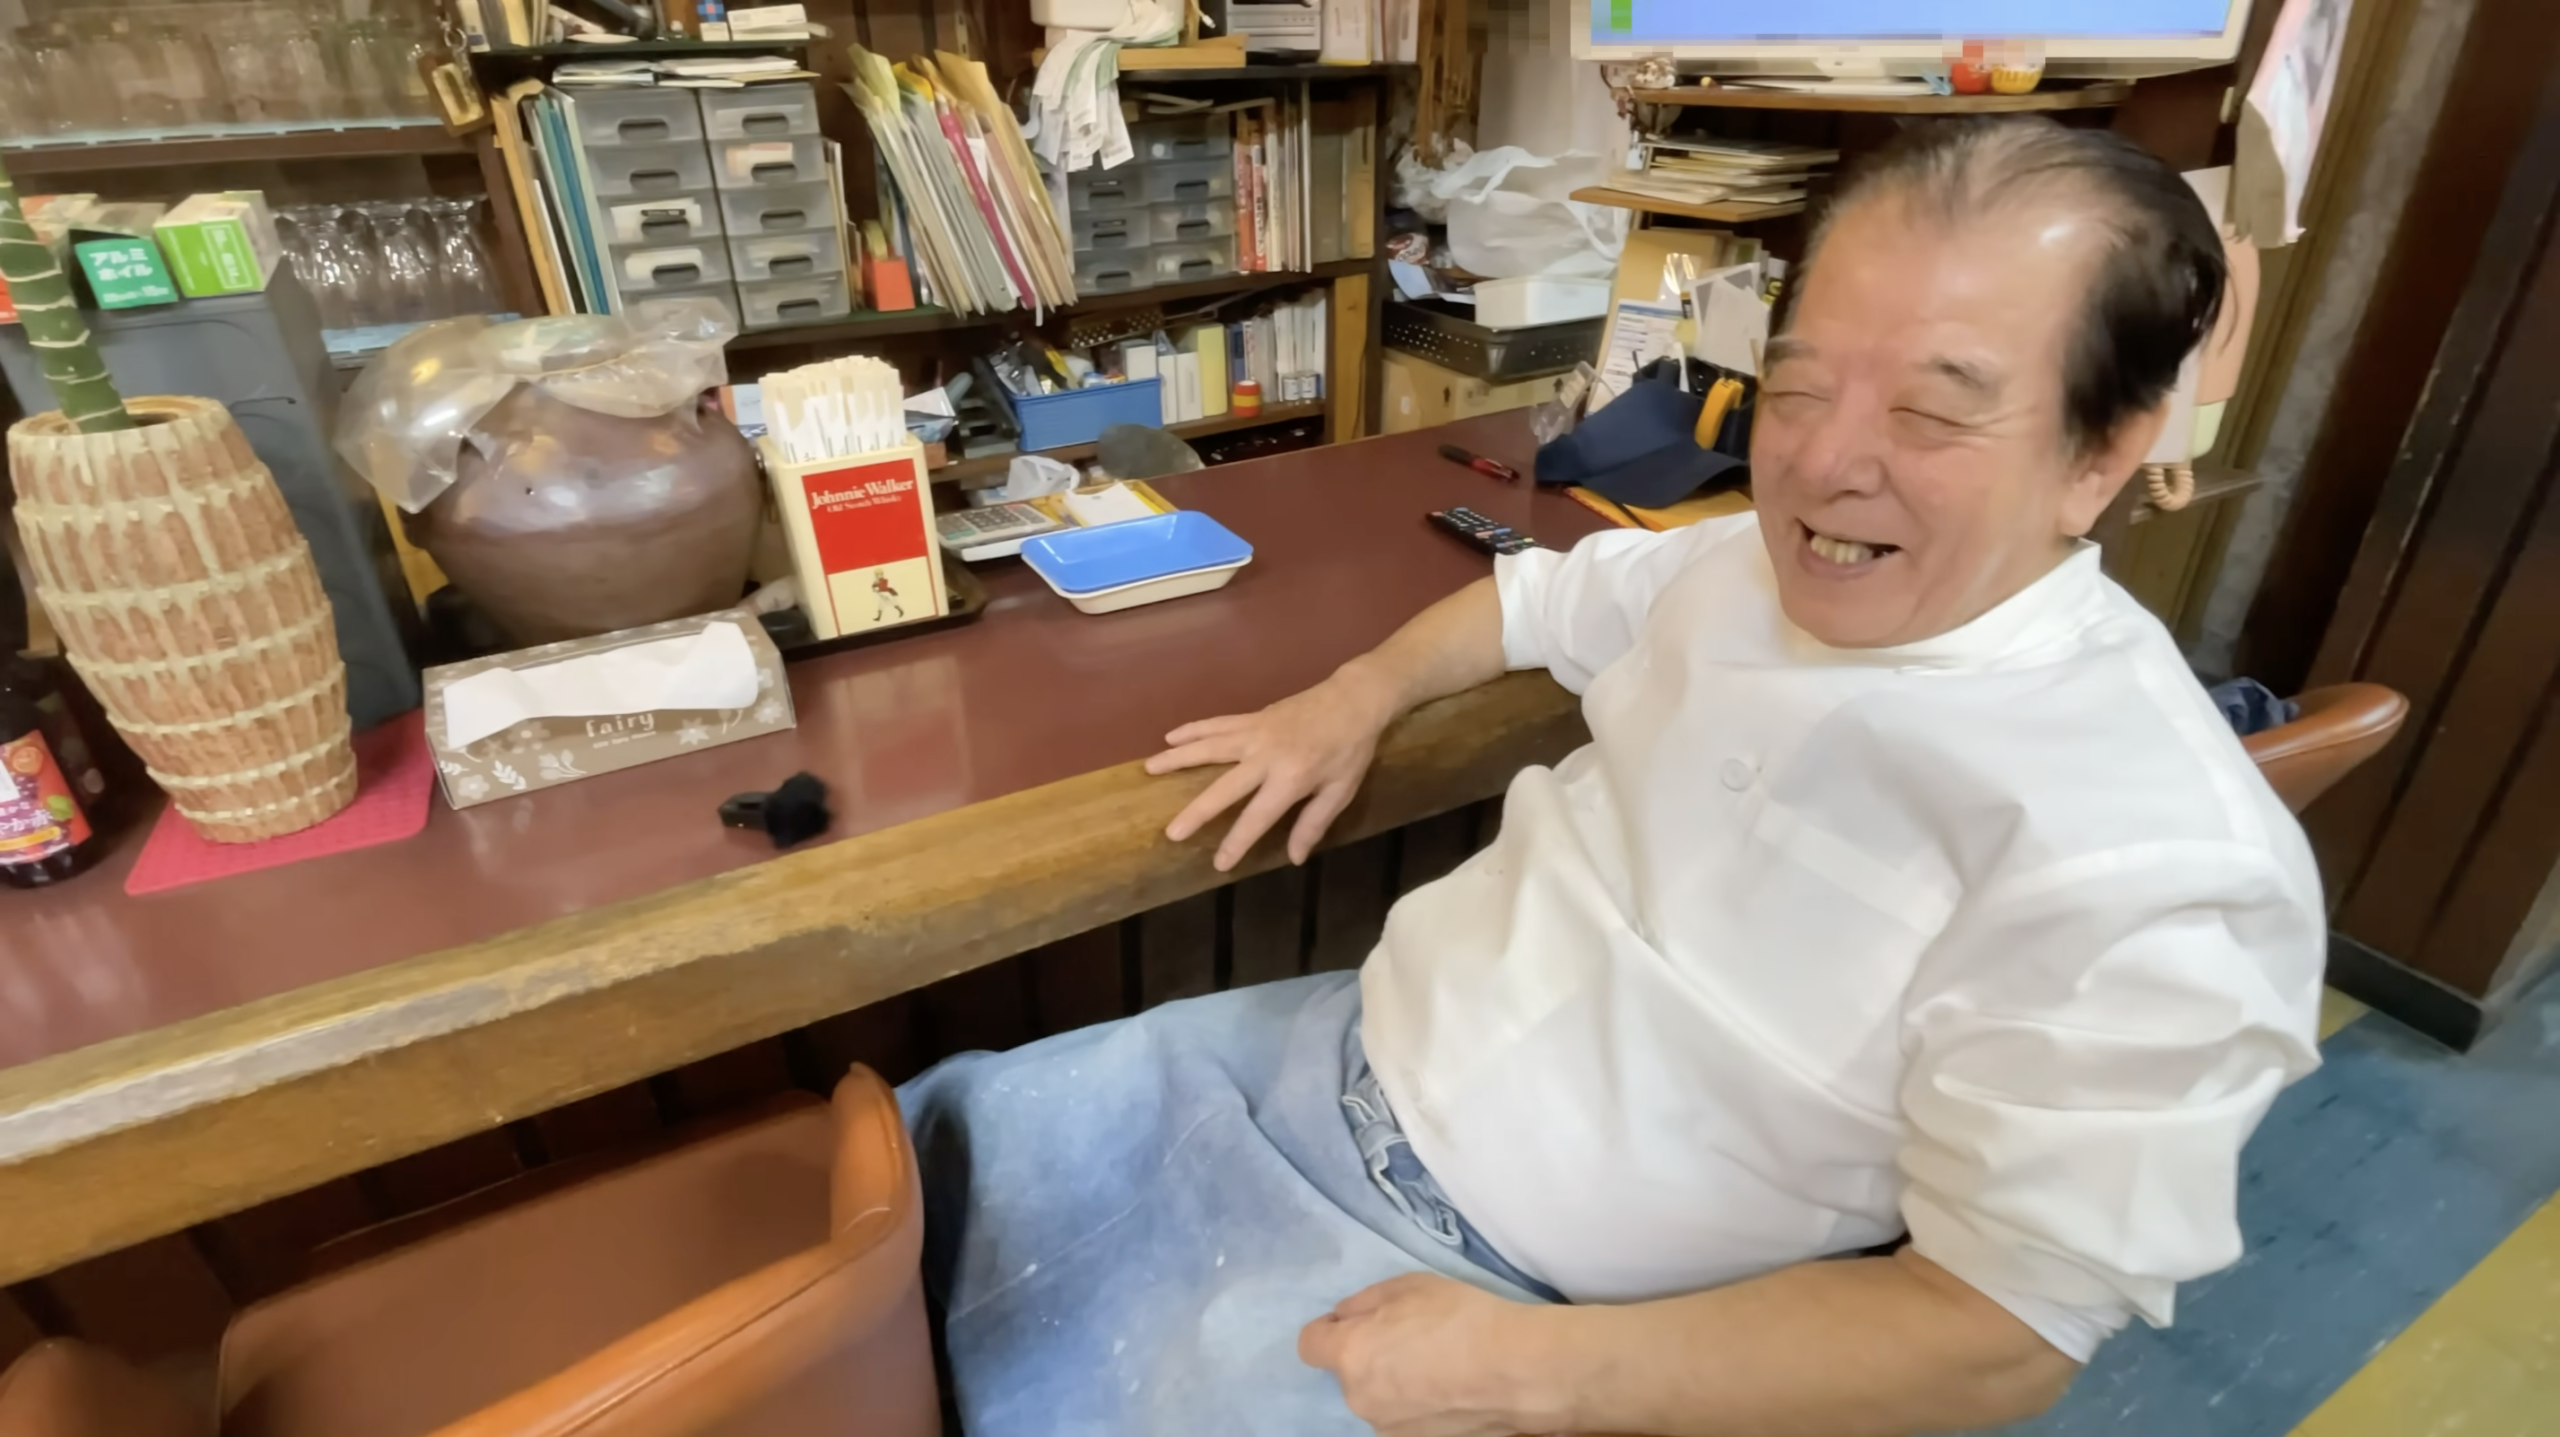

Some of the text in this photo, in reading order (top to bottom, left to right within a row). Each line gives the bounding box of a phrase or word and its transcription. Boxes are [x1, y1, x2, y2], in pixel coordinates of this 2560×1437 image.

[88, 247, 148, 267] アルミ
[97, 263, 154, 281] ホイル
[811, 478, 914, 509] Johnnie Walker
[585, 713, 654, 738] fairy
